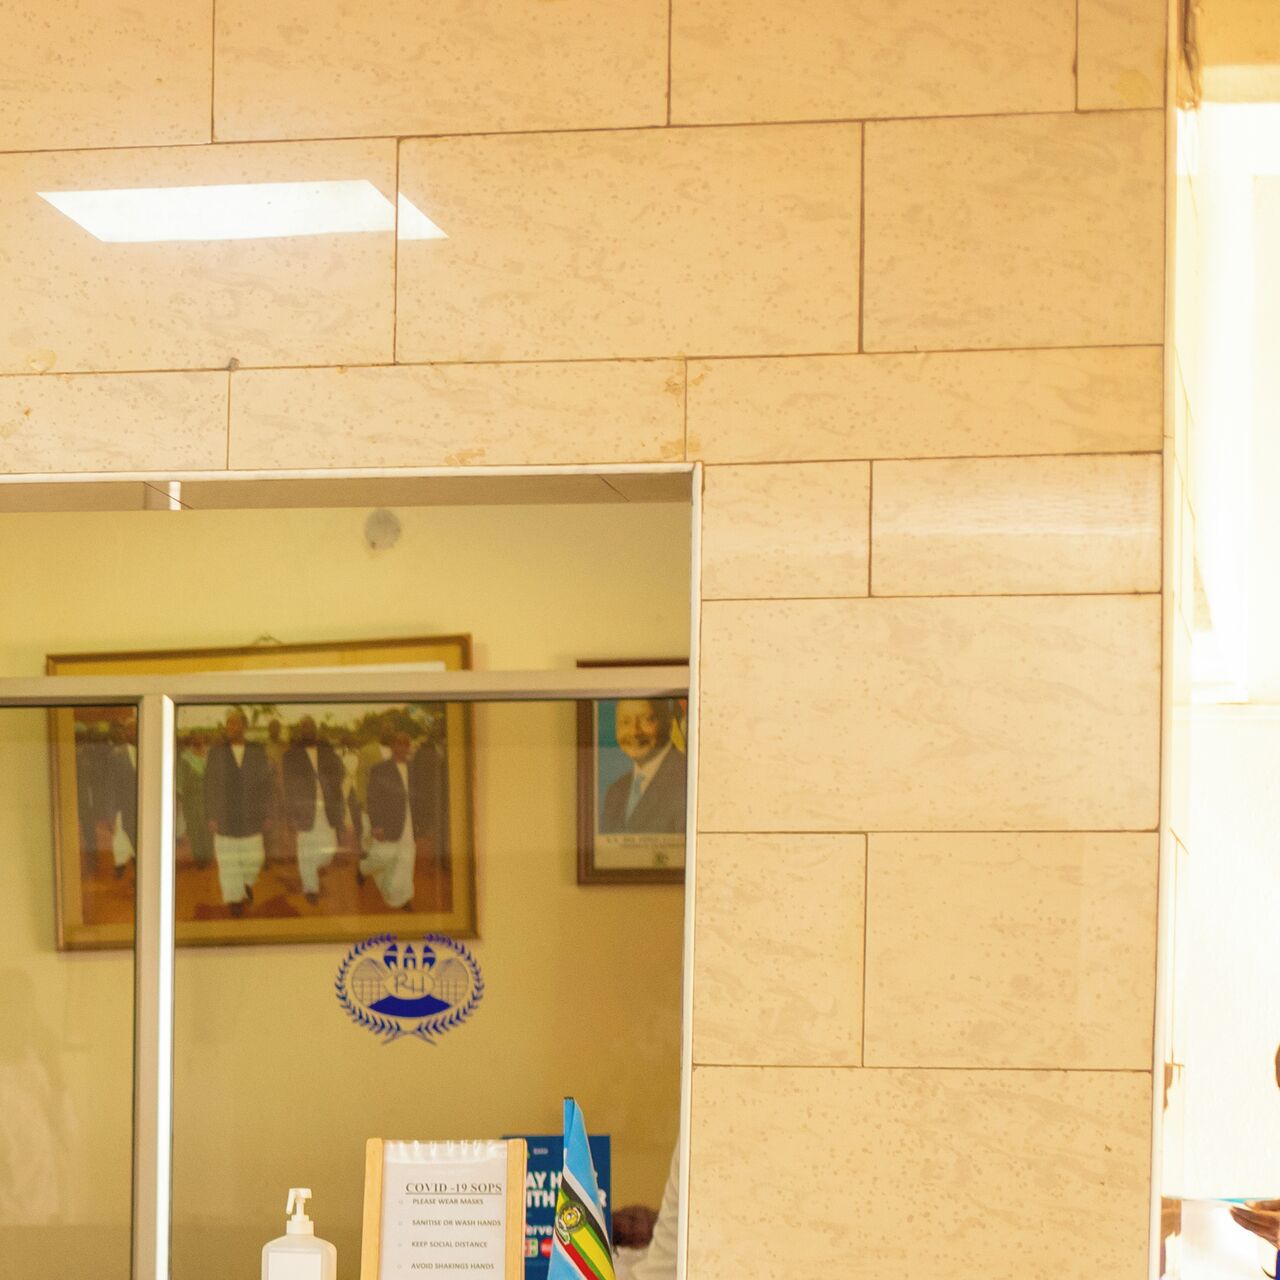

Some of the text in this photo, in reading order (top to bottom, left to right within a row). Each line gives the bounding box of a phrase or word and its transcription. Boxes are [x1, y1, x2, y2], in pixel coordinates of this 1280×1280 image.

[406, 1182, 502, 1193] COVID -19 SOPS
